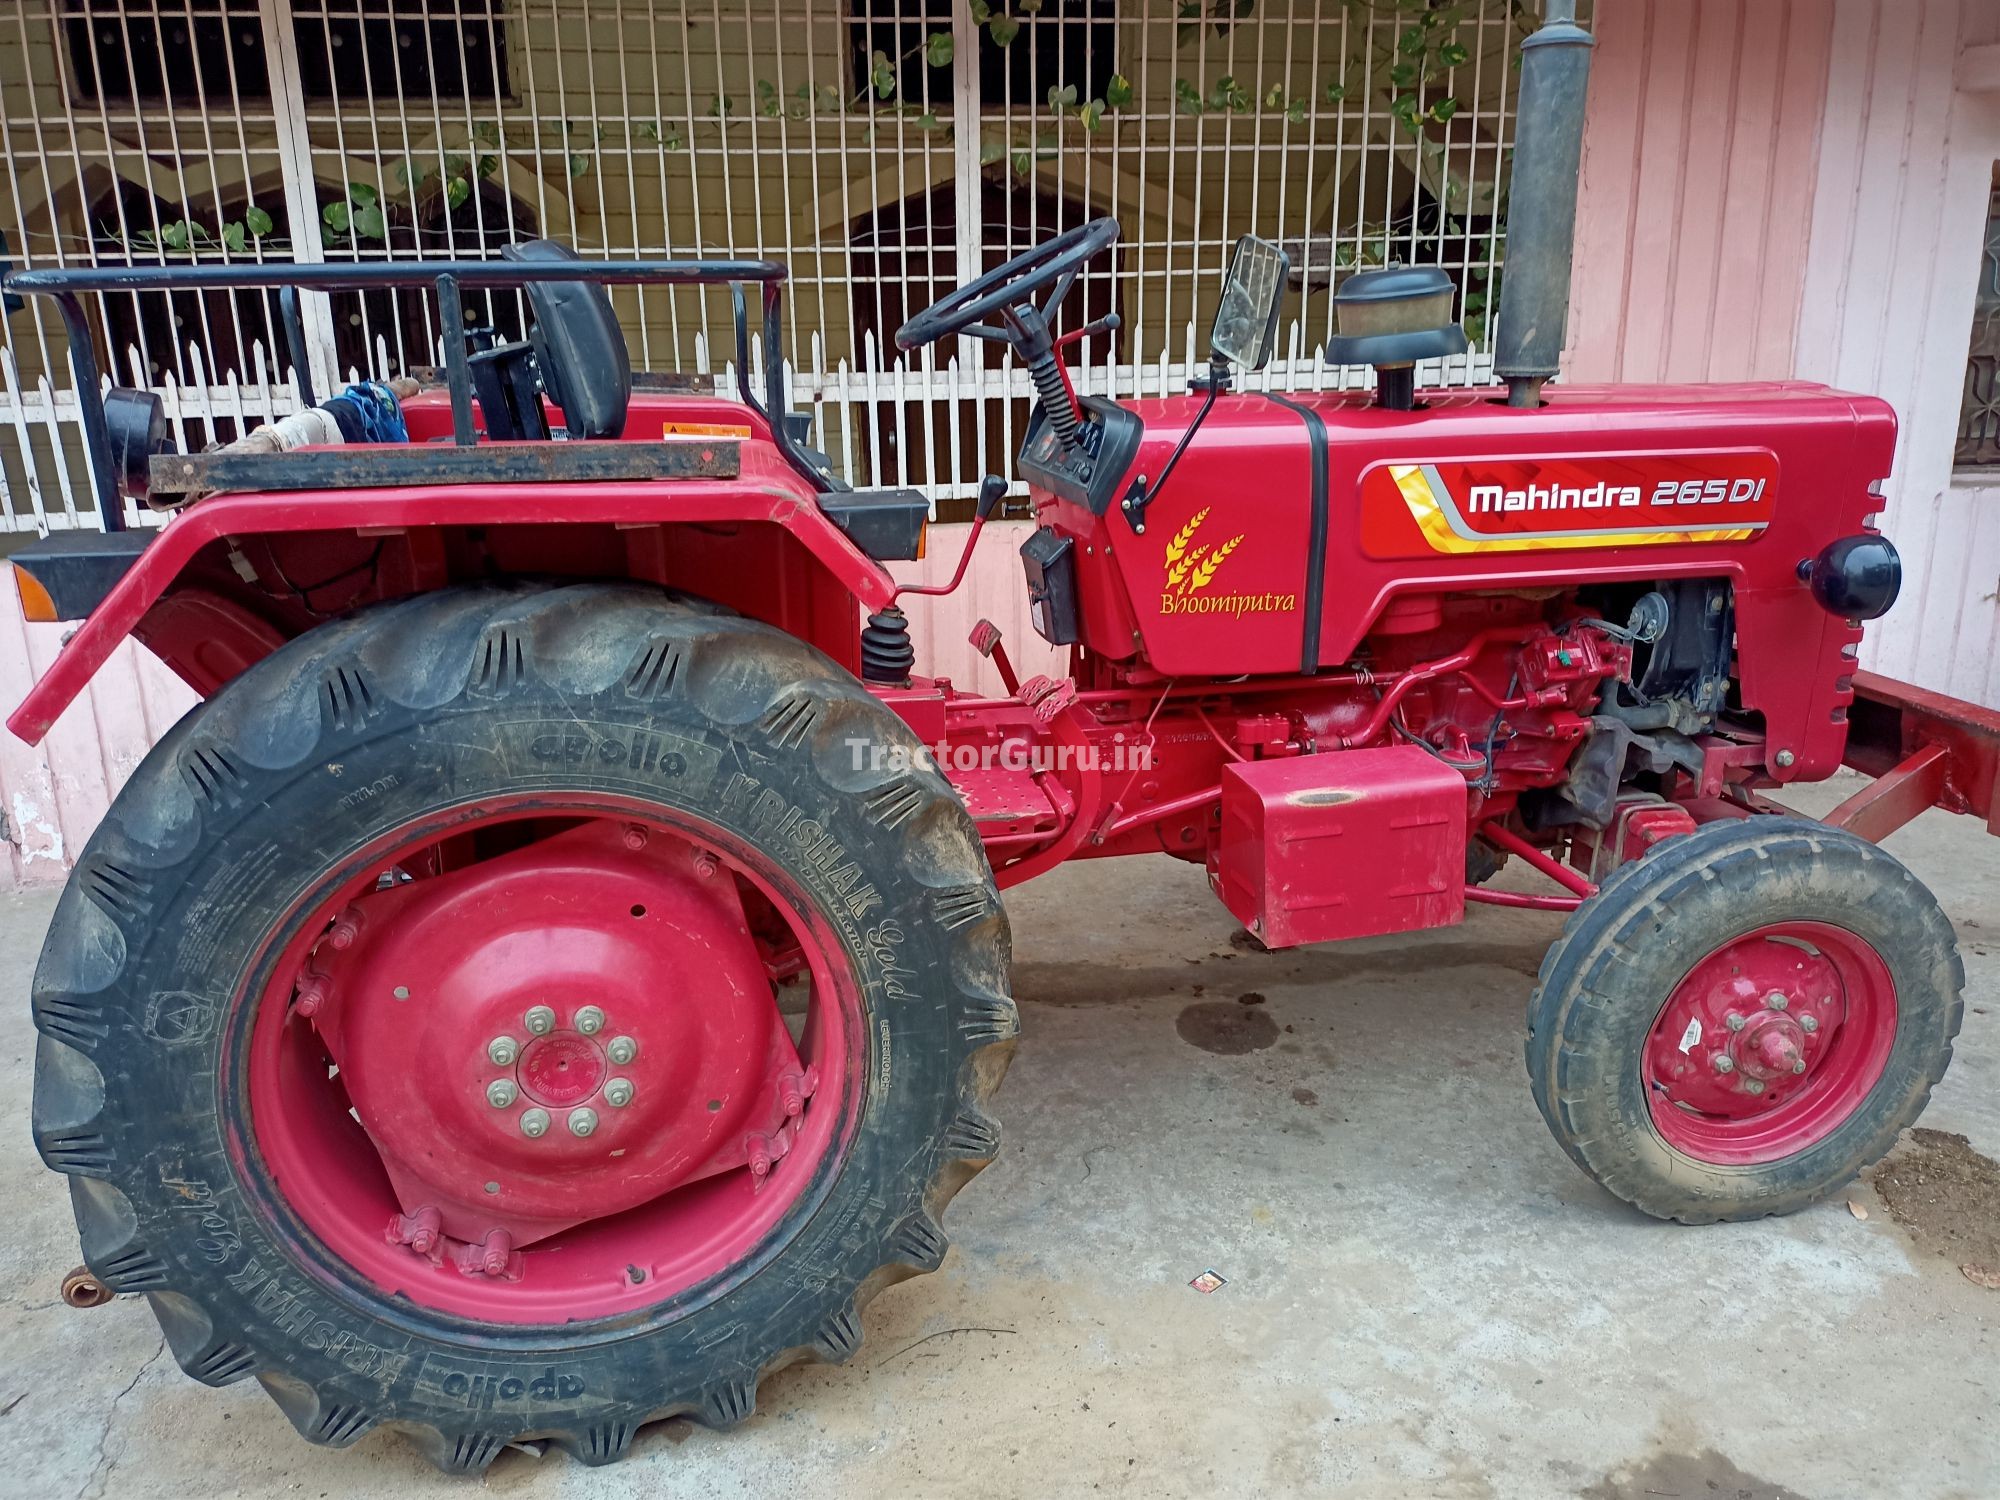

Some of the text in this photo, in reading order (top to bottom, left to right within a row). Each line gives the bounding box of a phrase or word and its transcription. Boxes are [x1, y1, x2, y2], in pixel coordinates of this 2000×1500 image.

[1468, 481, 1640, 512] Mahindra
[1159, 589, 1295, 620] Bhoomiputra
[531, 732, 687, 778] apollo
[721, 772, 923, 1000] KRISHAK Gold
[880, 1054, 892, 1089] NOTCH
[225, 1256, 409, 1385] KRISHAK
[442, 1366, 586, 1410] apollo
